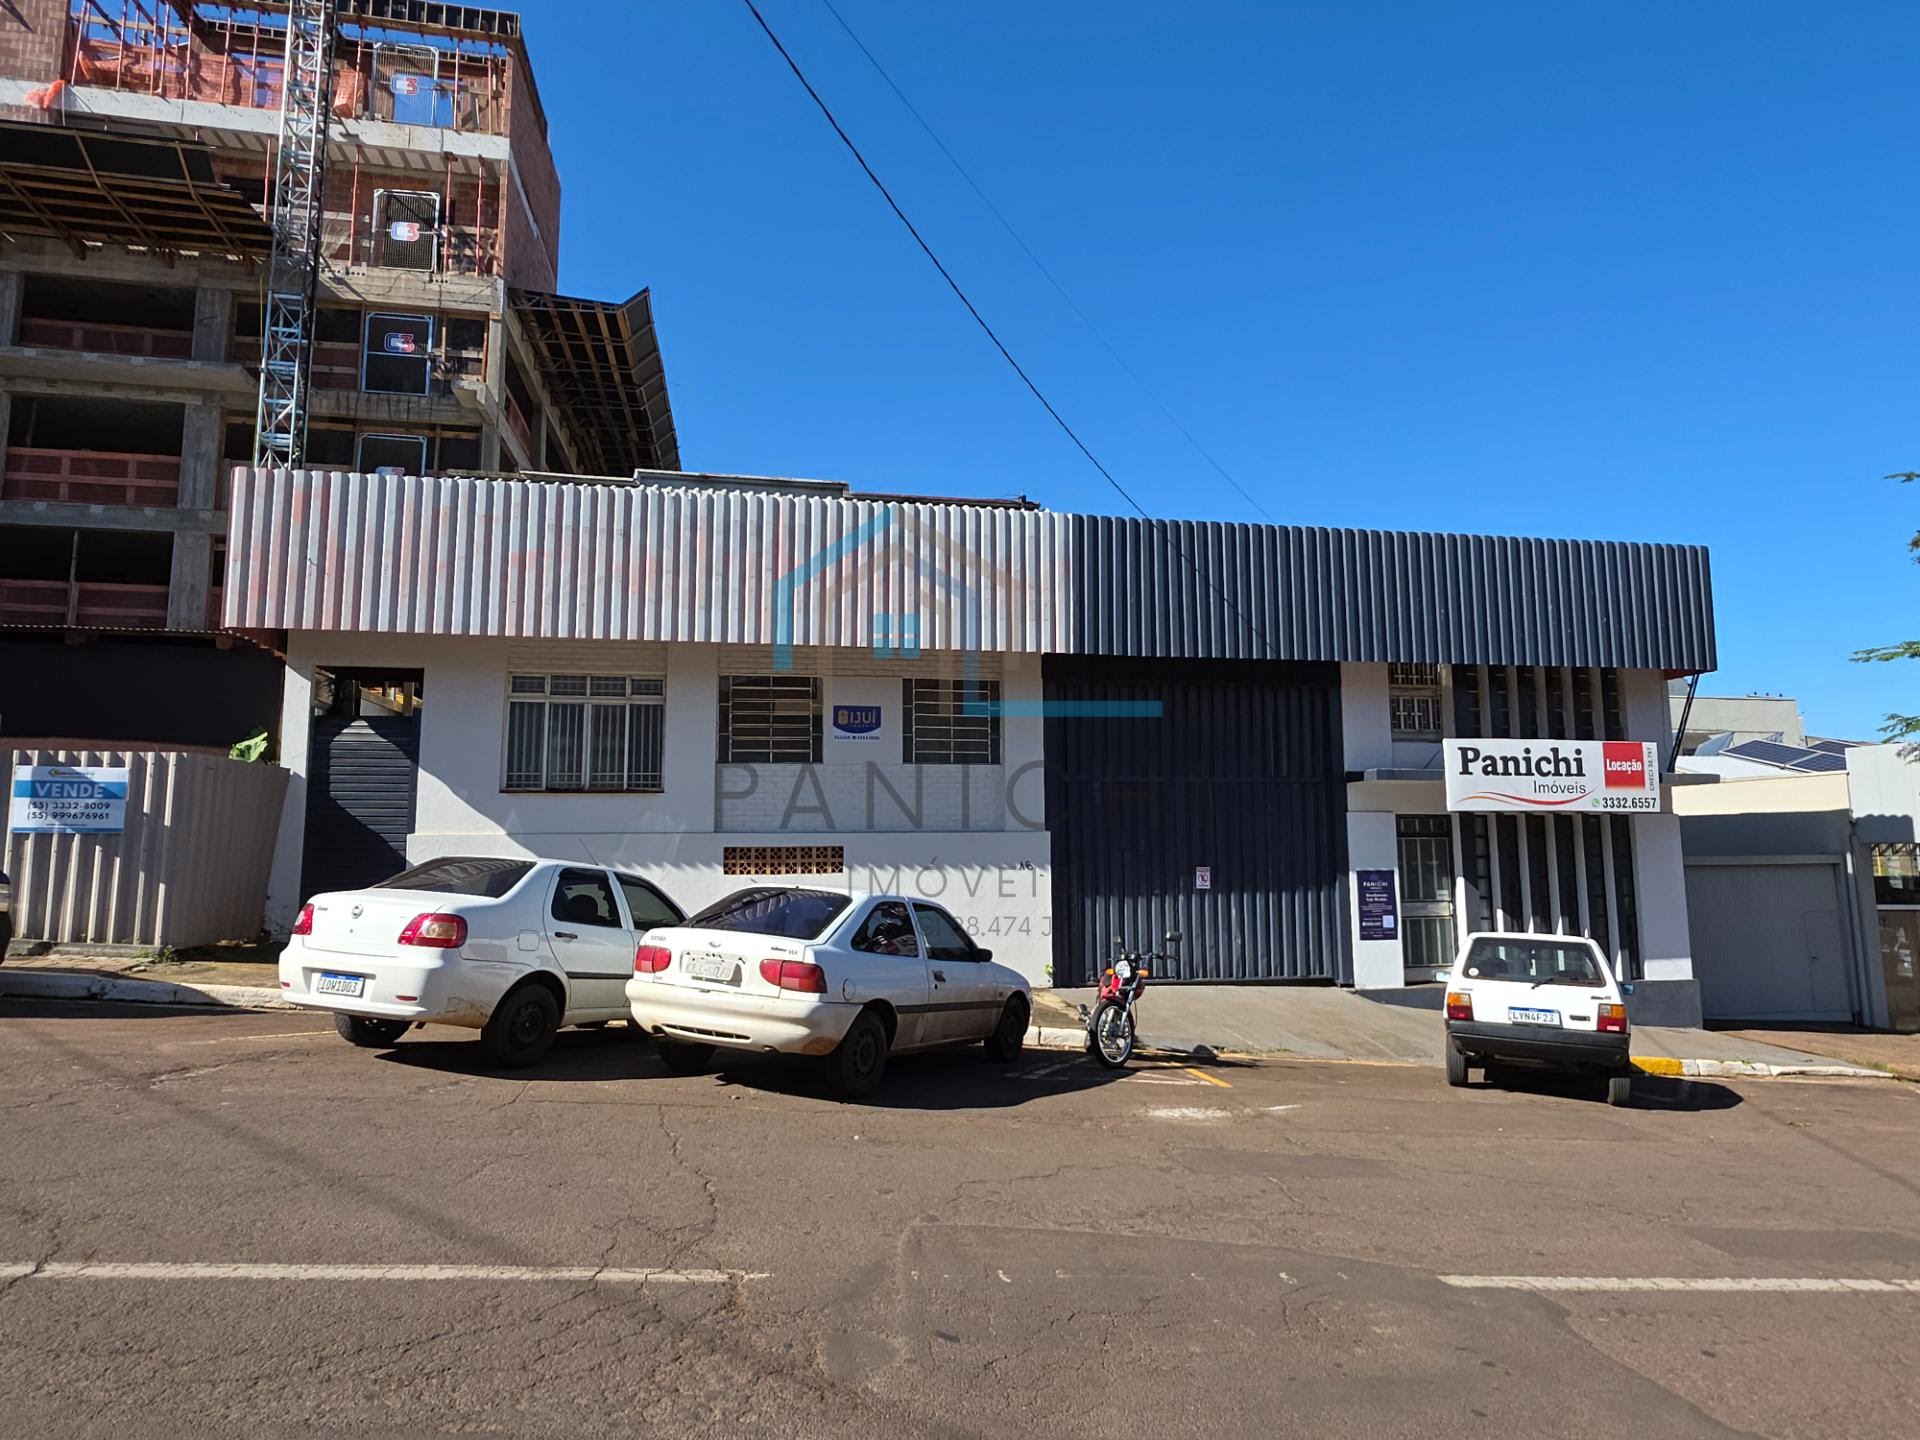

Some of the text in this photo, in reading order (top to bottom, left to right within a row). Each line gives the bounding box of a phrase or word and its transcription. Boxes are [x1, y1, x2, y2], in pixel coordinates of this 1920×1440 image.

[1457, 746, 1586, 778] Panichi
[1606, 758, 1642, 775] Locação
[35, 782, 104, 798] VENDE
[1533, 780, 1587, 794] Imóveis
[28, 802, 111, 811] (55) 3332-8009
[1602, 797, 1657, 809] 3332.6557
[27, 811, 109, 820] (55) 999676961
[1512, 1012, 1555, 1022] LYN4F23
